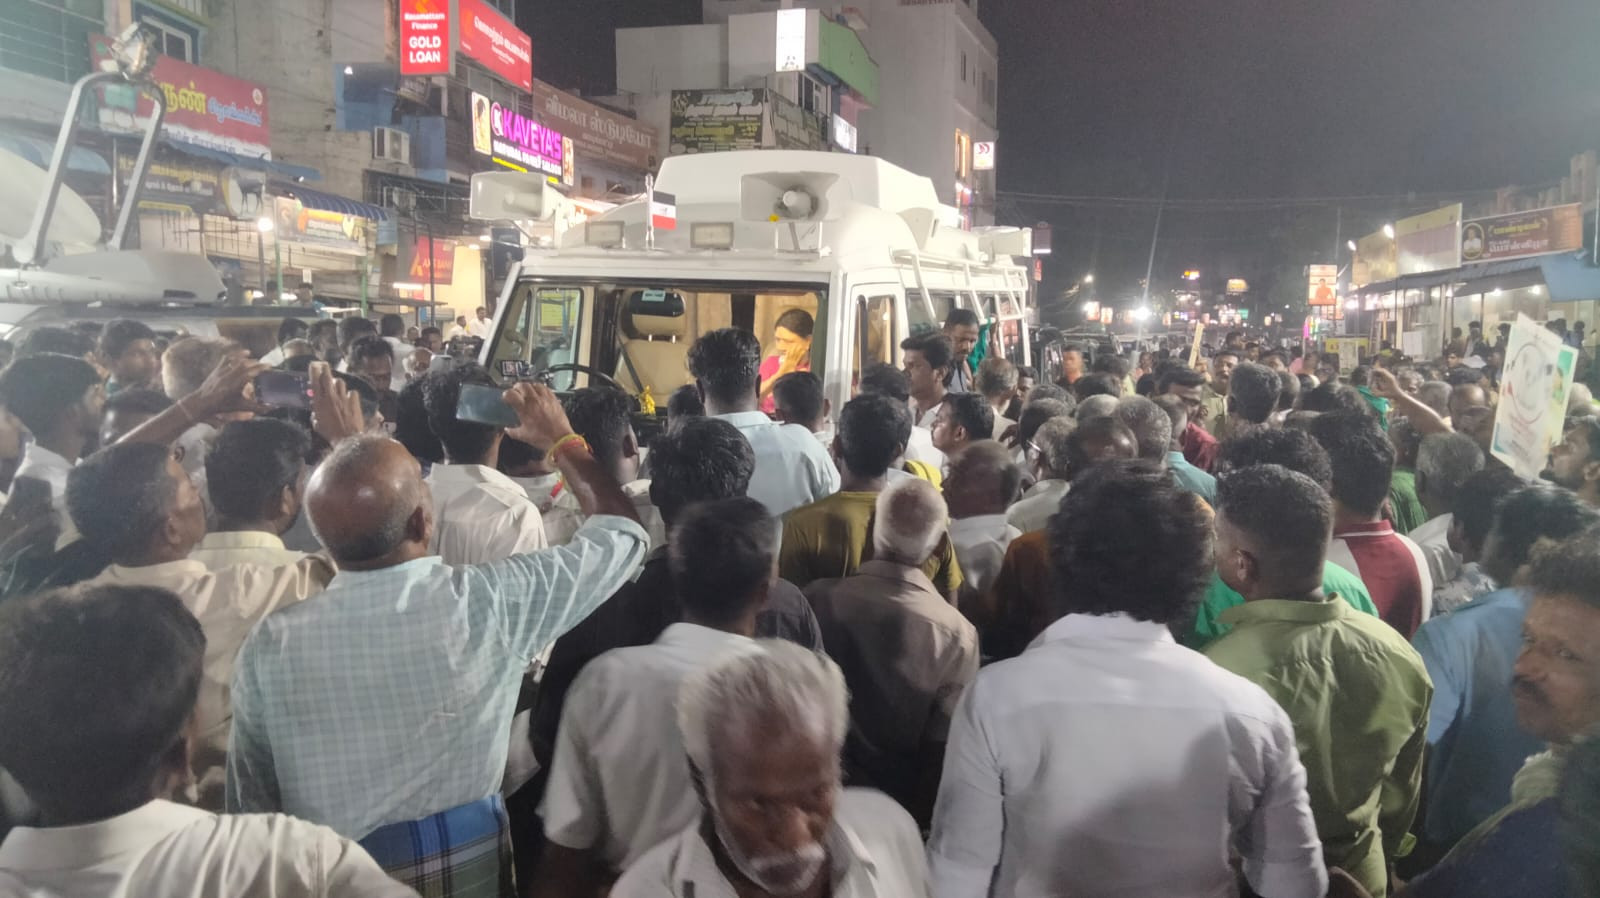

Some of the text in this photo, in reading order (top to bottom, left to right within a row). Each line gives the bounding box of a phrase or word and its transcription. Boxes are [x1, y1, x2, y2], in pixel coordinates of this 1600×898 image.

[409, 36, 442, 48] GOLD
[409, 50, 441, 63] LOAN
[503, 107, 562, 161] KAVEYA'S
